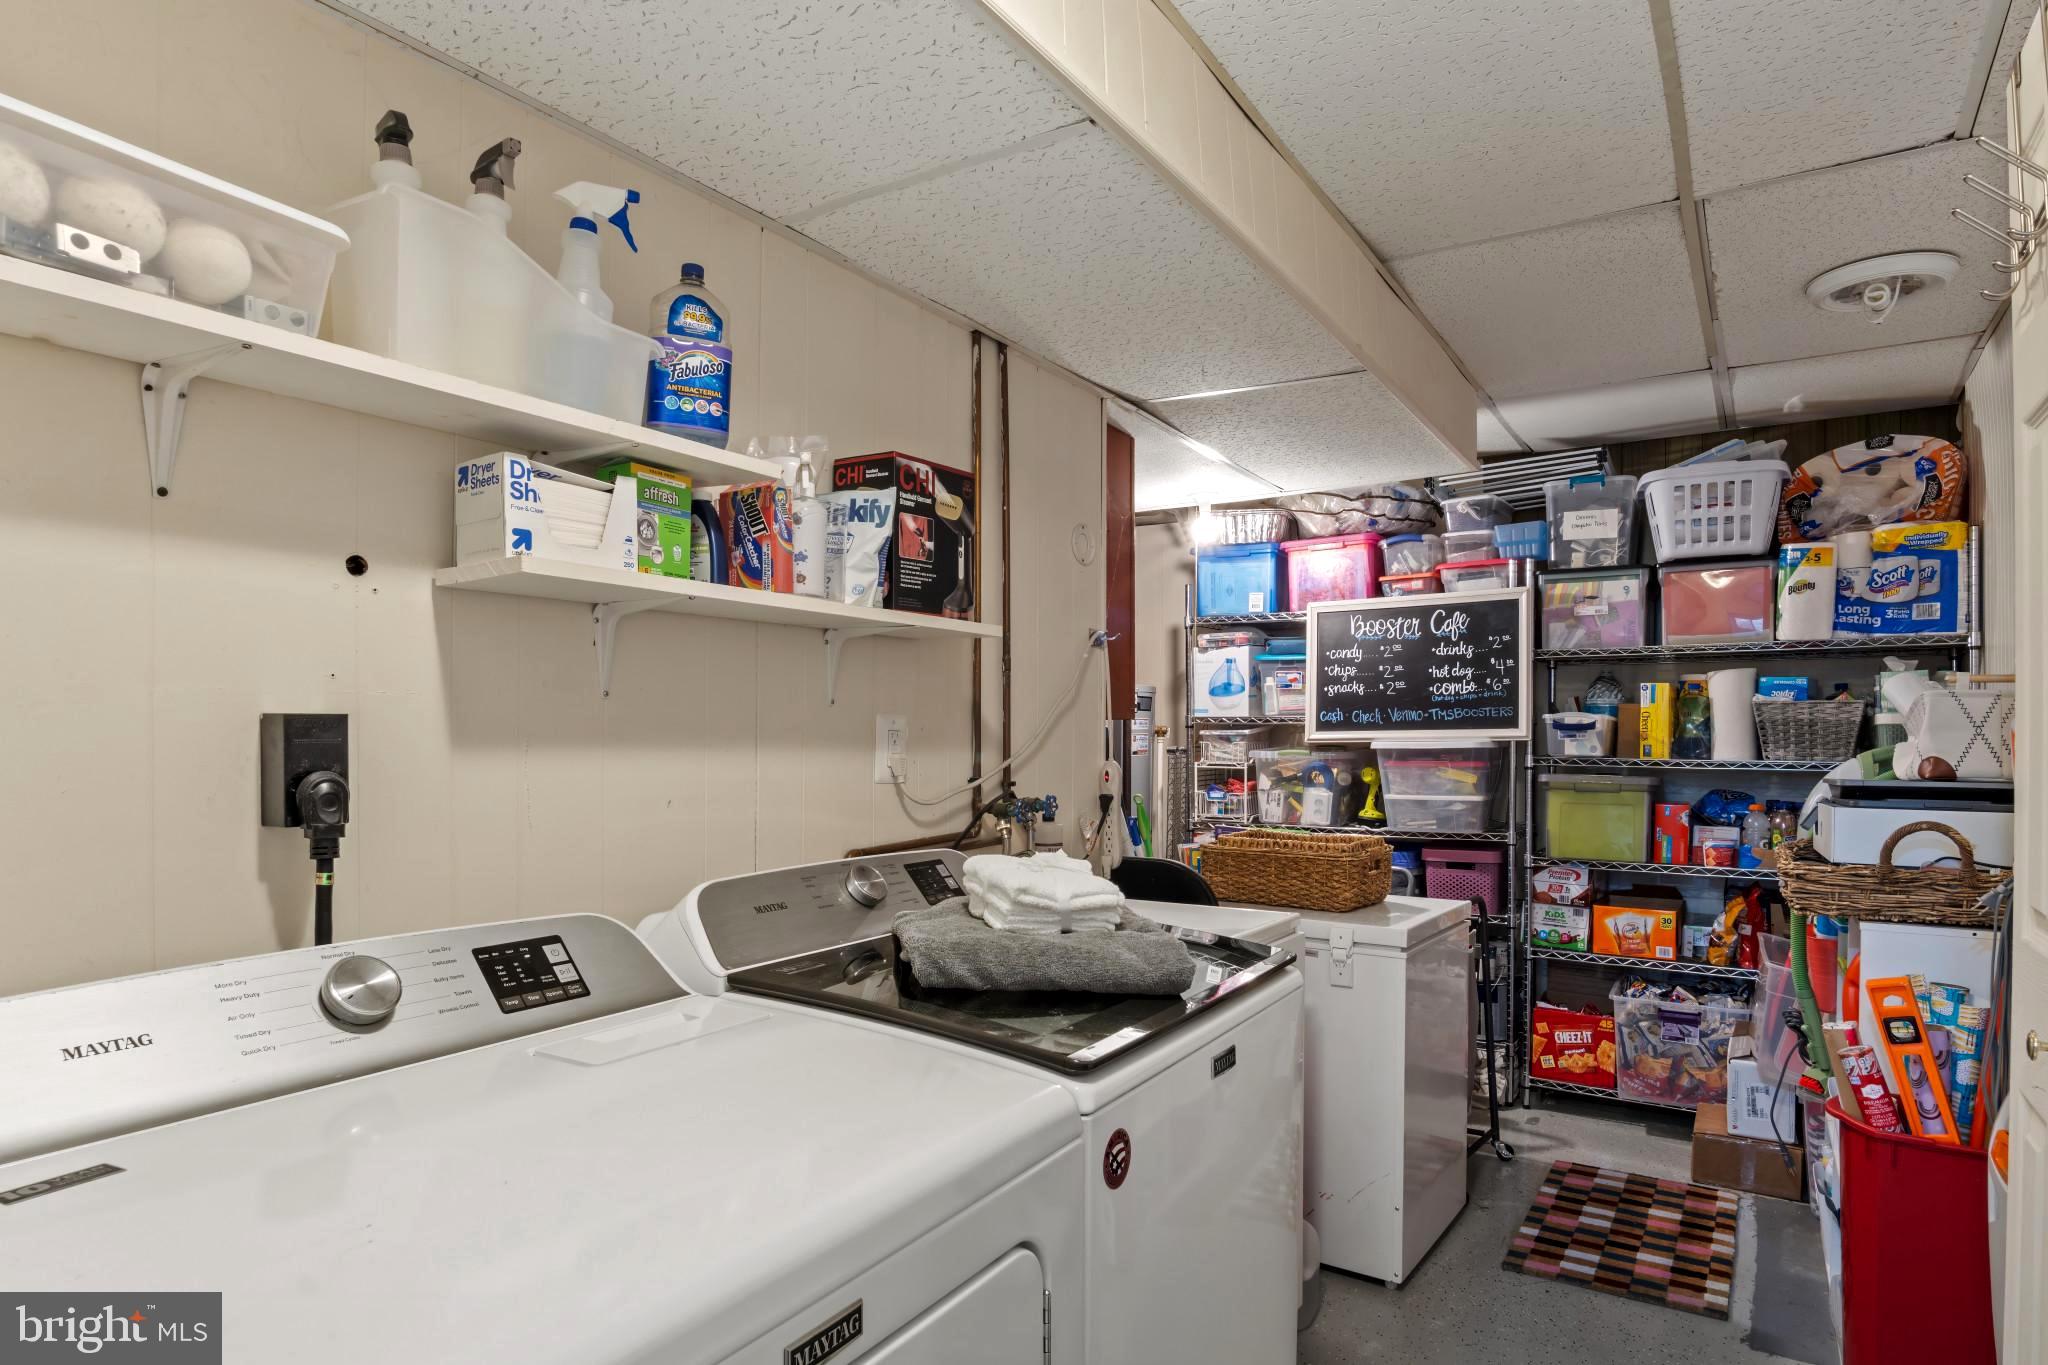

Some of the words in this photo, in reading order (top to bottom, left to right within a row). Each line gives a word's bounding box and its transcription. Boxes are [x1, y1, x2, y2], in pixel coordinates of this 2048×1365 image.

[668, 359, 724, 382] Fabuloso
[666, 384, 722, 399] ANTIBACTERIAL
[471, 462, 496, 477] Dryer
[834, 464, 864, 488] CHI
[470, 473, 500, 490] Sheets
[899, 463, 936, 498] CHI
[643, 486, 679, 506] affresh
[740, 492, 771, 538] SHOUT
[1872, 564, 1909, 588] Scott
[1788, 581, 1816, 596] Bounty
[1838, 604, 1871, 617] Long
[1884, 609, 1894, 619] 3
[1350, 613, 1422, 641] Booster
[1835, 614, 1882, 628] asting
[1330, 642, 1363, 662] candy
[1435, 640, 1475, 659] drinks
[1328, 663, 1358, 682] chips
[1432, 664, 1450, 678] hot
[1451, 661, 1475, 680] dog
[1327, 680, 1366, 697] snacks
[1433, 679, 1478, 696] combo
[1319, 707, 1345, 725] Cash
[1351, 708, 1384, 725] Check
[1547, 867, 1573, 877] Premier
[1548, 873, 1571, 882] Protein
[753, 901, 789, 915] MAYTAG
[1660, 917, 1673, 925] 30
[214, 981, 233, 989] More
[234, 979, 247, 987] Dry
[433, 976, 450, 984] Bulky
[219, 994, 243, 1003] Heavy
[243, 991, 261, 1000] Duty
[239, 1012, 256, 1021] Only
[1599, 1019, 1614, 1029] 45
[234, 1031, 257, 1041] Timed
[258, 1029, 271, 1037] Dry
[1554, 1030, 1593, 1044] CHEEZ-IT
[59, 1033, 153, 1062] MAYTAG
[241, 1048, 262, 1057] Quick
[262, 1044, 276, 1053] Dry
[794, 1312, 860, 1365] MAYTAG
